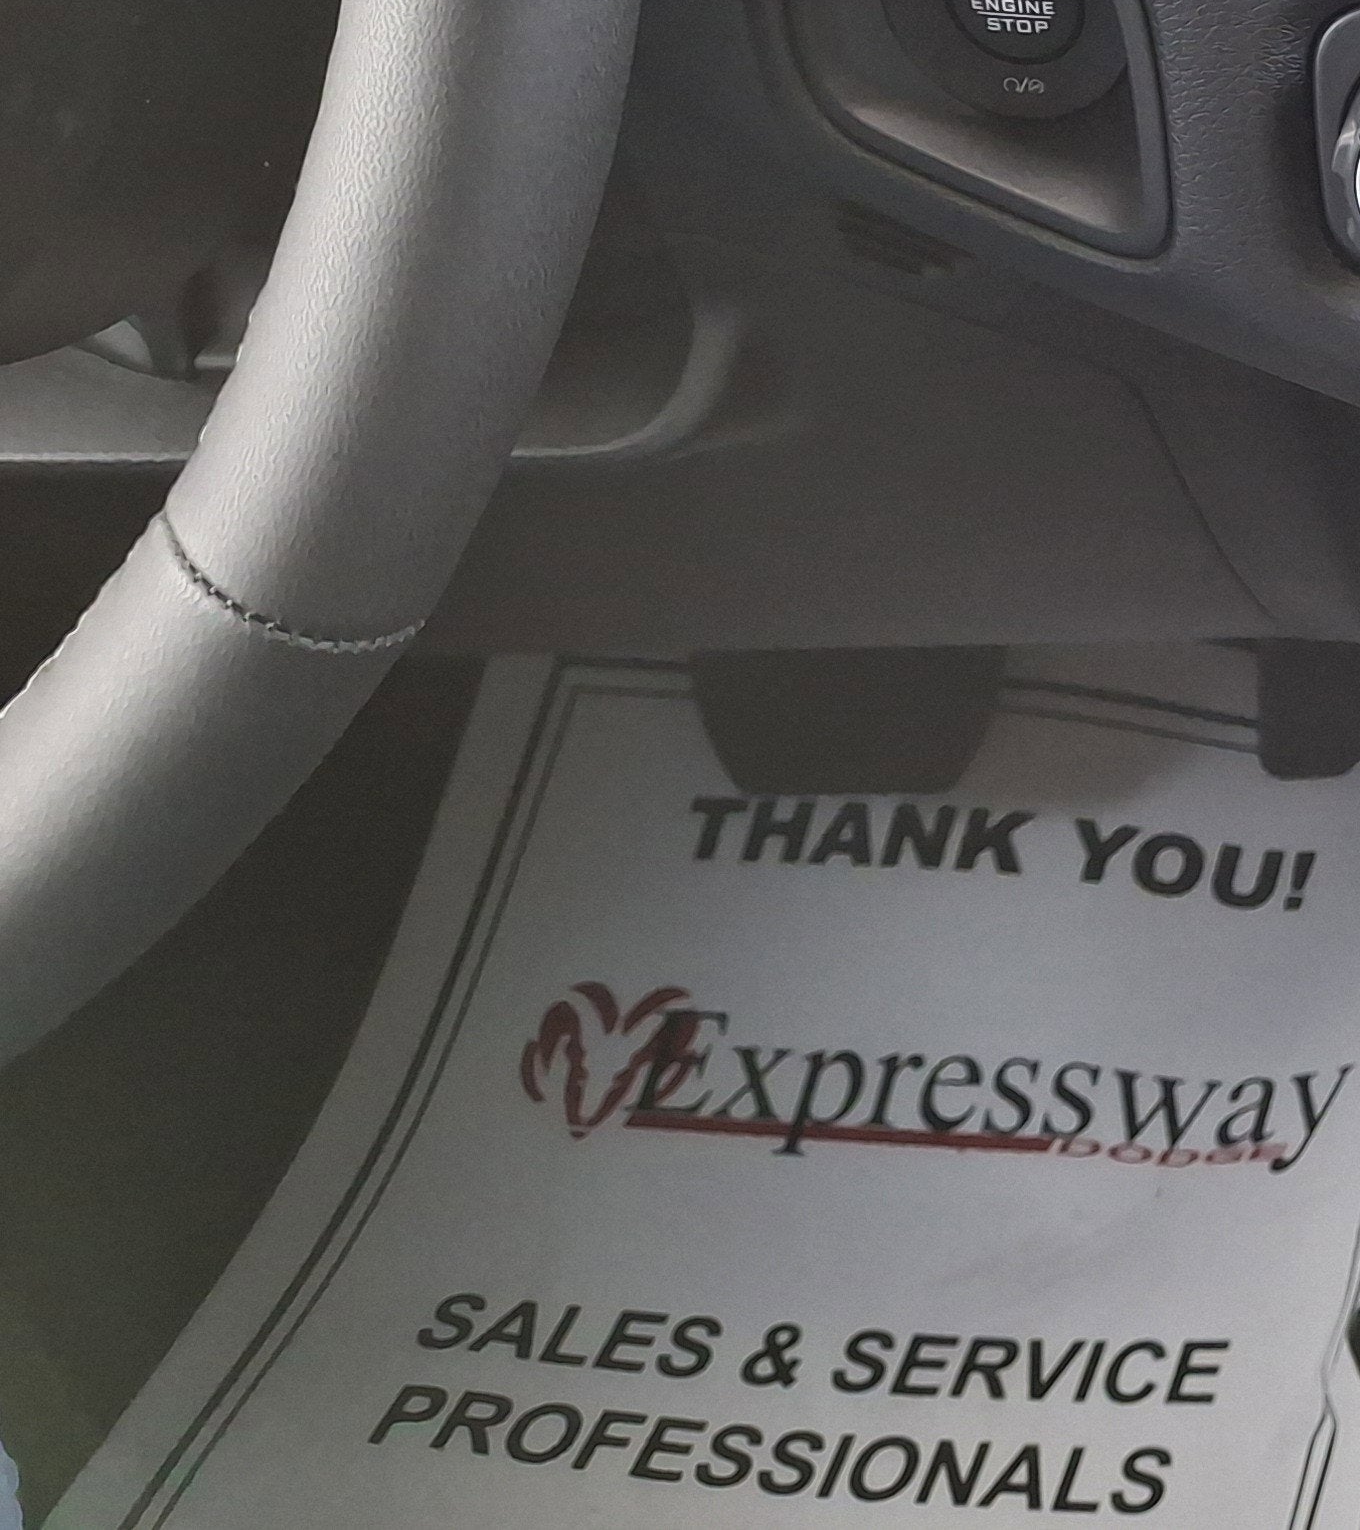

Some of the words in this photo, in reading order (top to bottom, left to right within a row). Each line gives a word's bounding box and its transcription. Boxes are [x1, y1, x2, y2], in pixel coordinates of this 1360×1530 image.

[986, 17, 1049, 34] STOP
[690, 795, 1038, 876] THANK
[1075, 816, 1318, 912] YOU!
[636, 1009, 1354, 1173] Expressway
[416, 1291, 725, 1378] SALES
[739, 1322, 805, 1389] &
[830, 1327, 1230, 1405] SERVICE
[367, 1383, 1173, 1514] PROFESSIONALS
